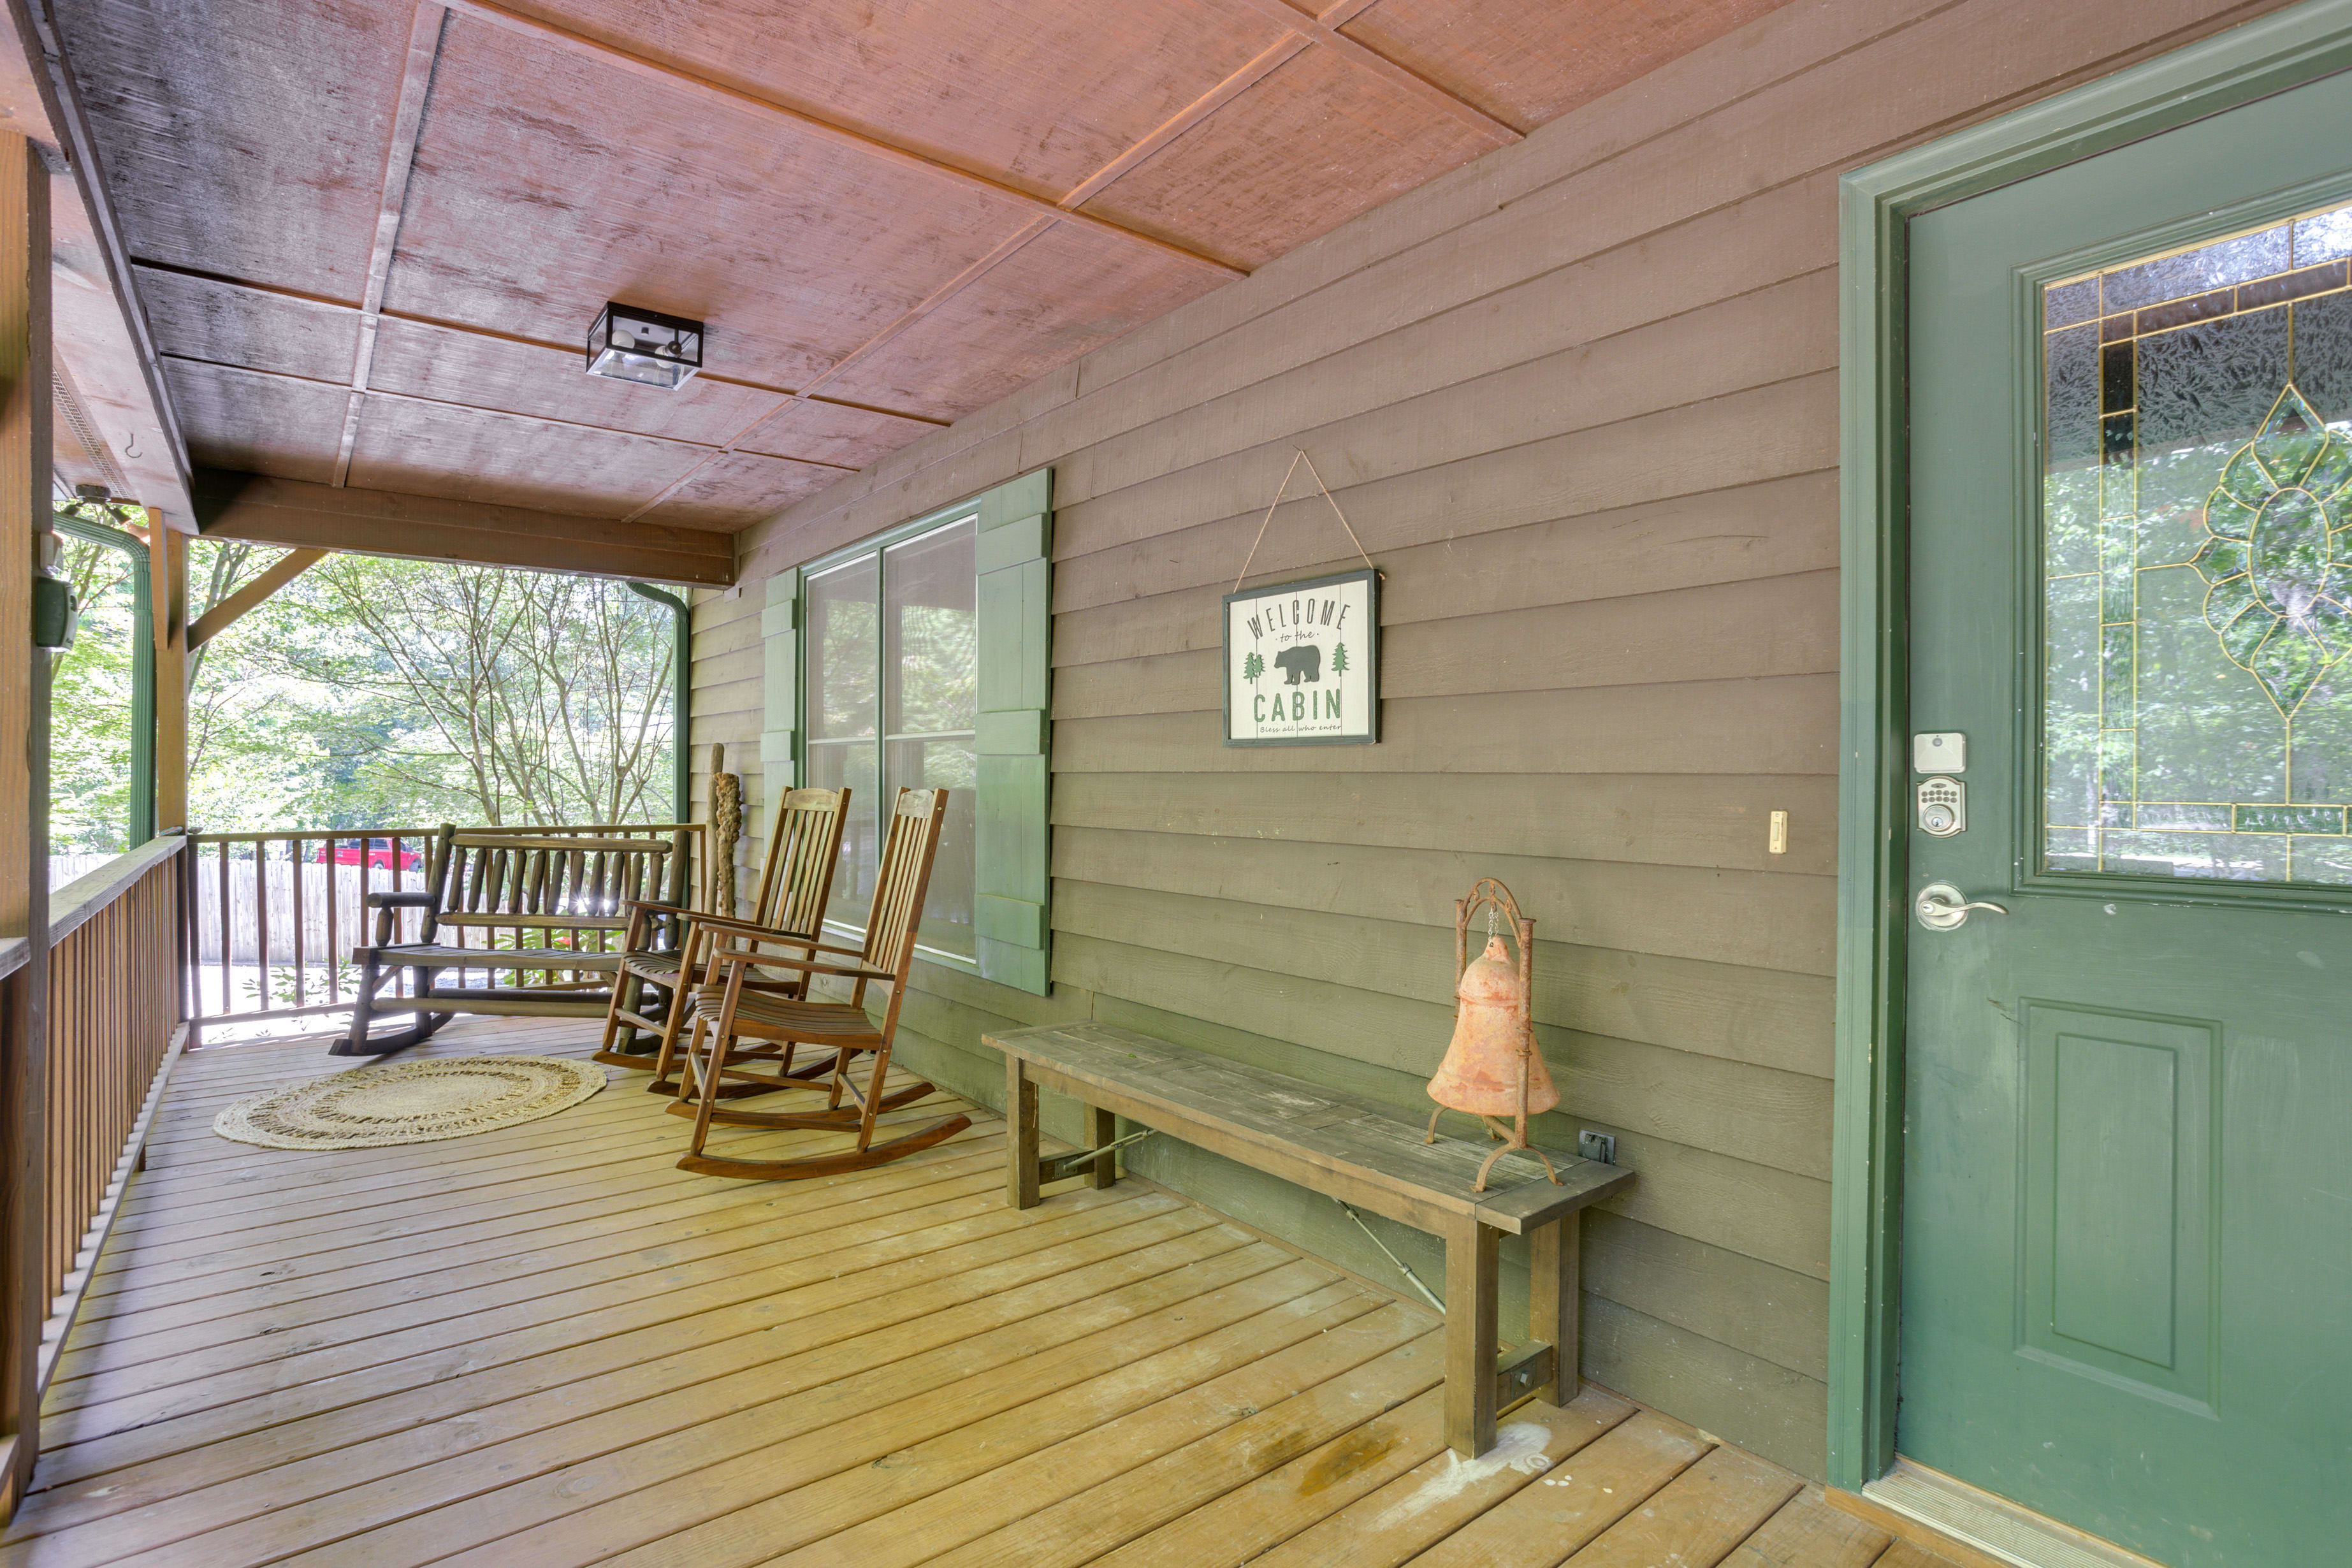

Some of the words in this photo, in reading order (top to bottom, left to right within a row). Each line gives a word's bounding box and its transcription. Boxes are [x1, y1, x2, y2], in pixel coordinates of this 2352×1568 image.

[1247, 598, 1351, 640] WELCOME
[1280, 633, 1292, 642] to
[1295, 630, 1315, 641] the
[1254, 688, 1340, 722] CABIN
